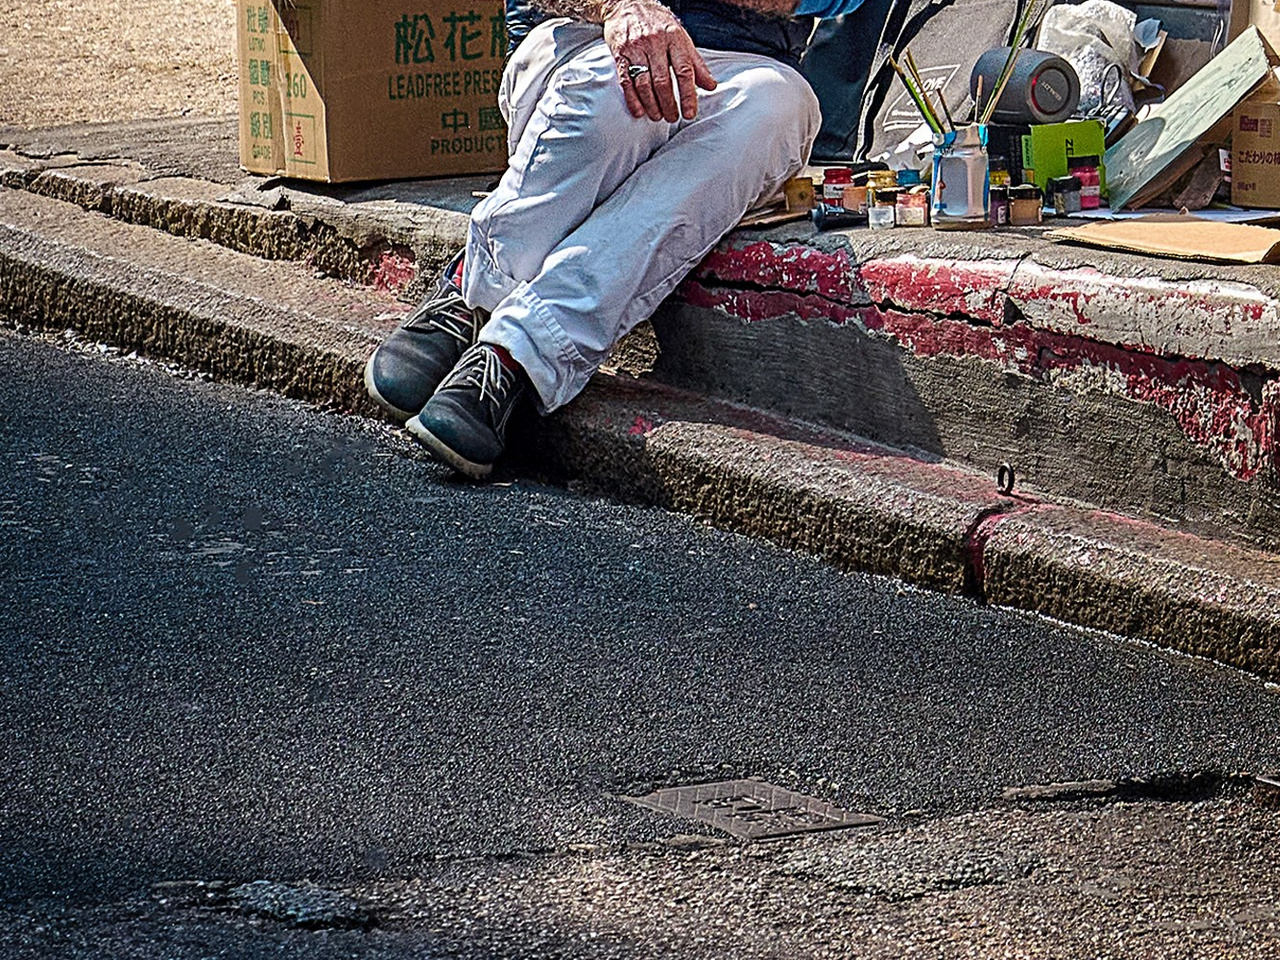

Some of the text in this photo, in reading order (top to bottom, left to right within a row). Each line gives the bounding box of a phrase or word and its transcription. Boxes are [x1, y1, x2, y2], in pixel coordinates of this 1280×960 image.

[284, 72, 308, 100] 160
[388, 70, 462, 100] LEADFREE
[441, 107, 503, 133] 中國
